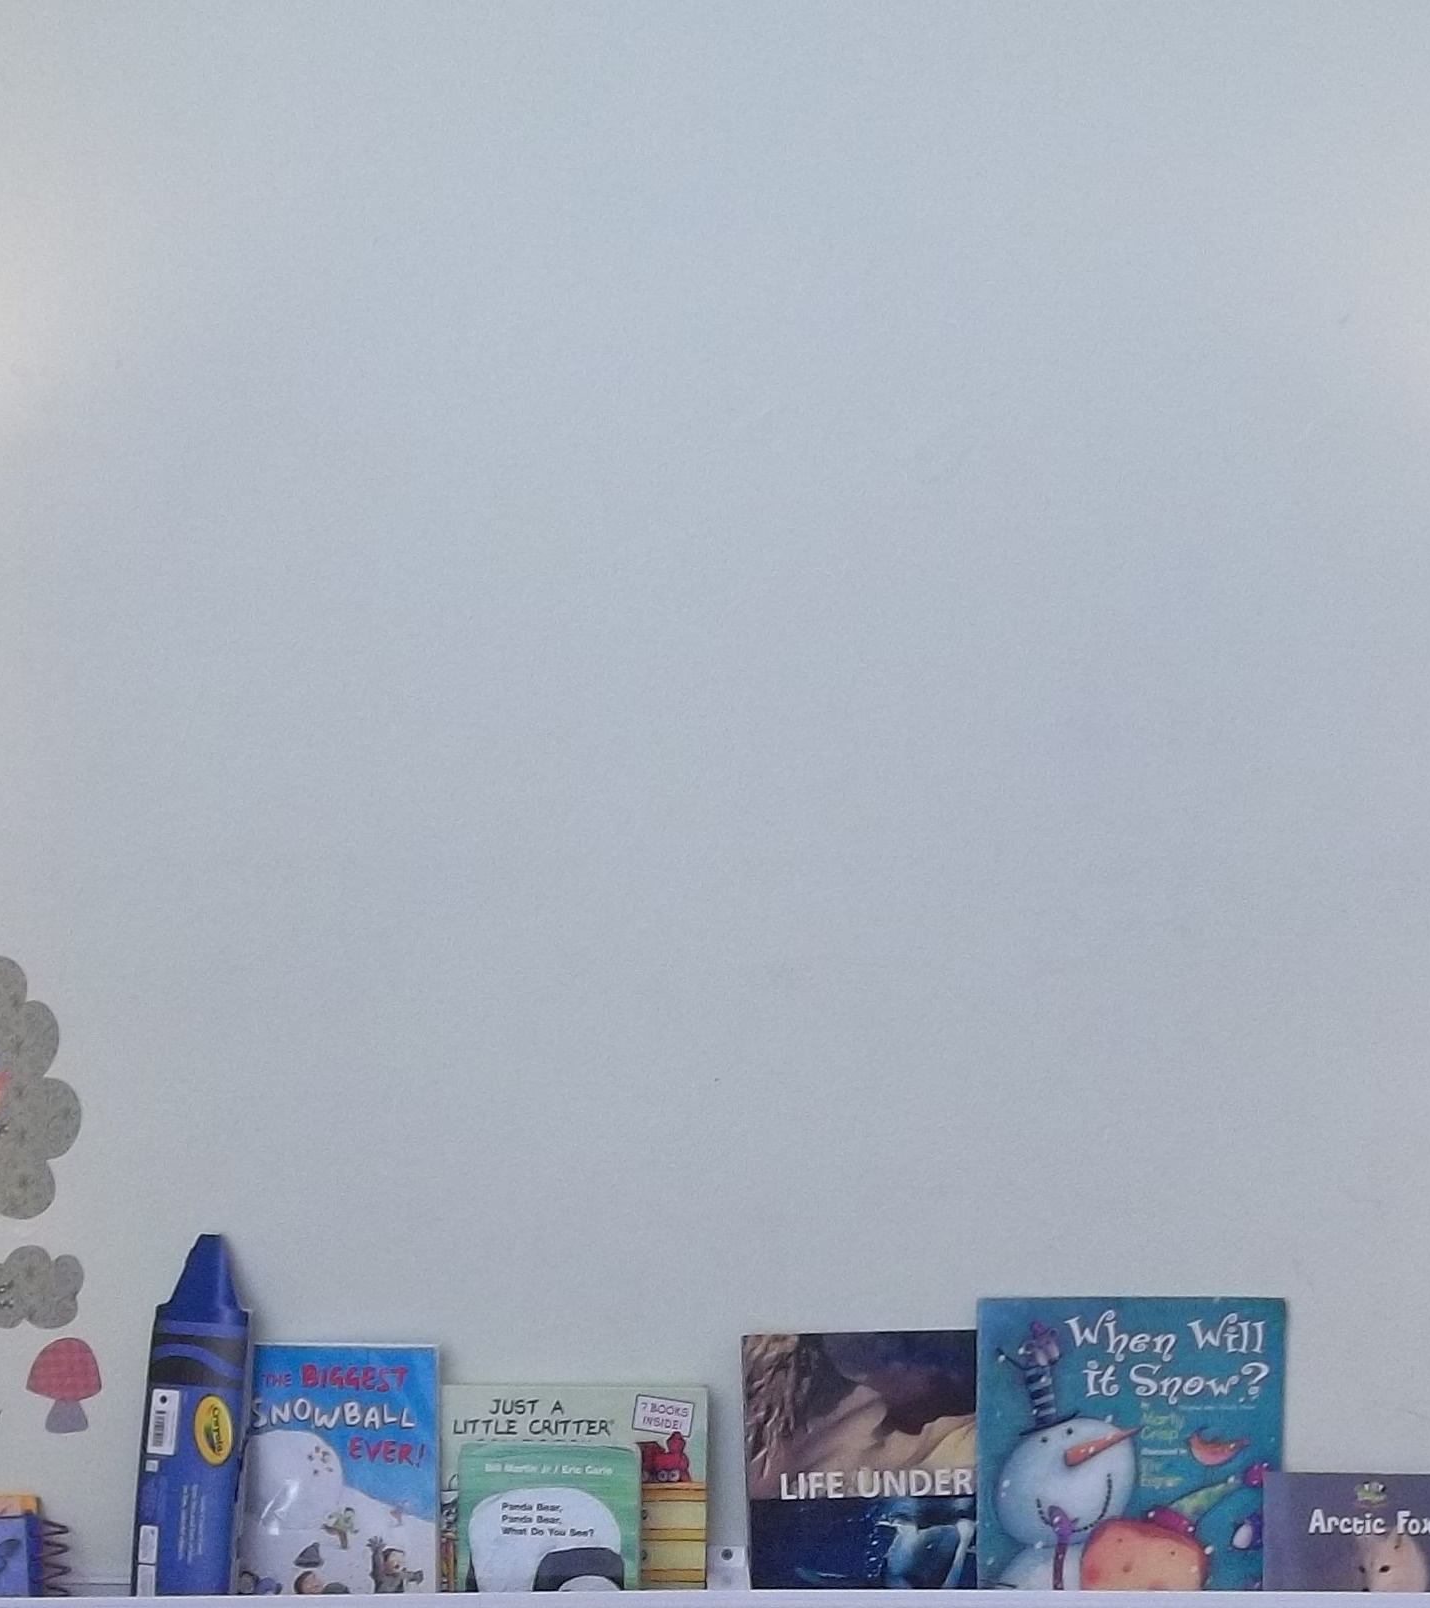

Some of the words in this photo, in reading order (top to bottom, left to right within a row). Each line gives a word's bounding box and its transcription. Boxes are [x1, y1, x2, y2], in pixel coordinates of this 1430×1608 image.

[1065, 1310, 1177, 1362] When
[1187, 1313, 1266, 1354] Will
[262, 1373, 292, 1387] THE
[301, 1364, 409, 1393] BIGGEST
[1128, 1362, 1270, 1405] Snow?
[252, 1398, 416, 1430] SNOWBALL
[489, 1399, 539, 1414] JUST
[551, 1400, 564, 1415] A
[650, 1402, 688, 1417] BOOKS
[210, 1405, 225, 1453] Crayola
[453, 1419, 518, 1435] LITTLE
[529, 1419, 611, 1436] CRITTER
[643, 1416, 682, 1430] INSIDE!
[348, 1437, 426, 1467] EVER!
[485, 1464, 502, 1473] Bill
[504, 1464, 538, 1473] Martin
[562, 1465, 582, 1474] Eric
[585, 1465, 613, 1475] Carle
[780, 1471, 845, 1500] LIFE
[857, 1467, 974, 1497] UNDER
[501, 1502, 533, 1511] Panda
[537, 1503, 563, 1513] Bear,
[501, 1514, 533, 1523] Panda
[537, 1515, 563, 1525] Bear,
[1308, 1508, 1386, 1536] Arctic
[501, 1527, 527, 1536] What
[531, 1527, 544, 1536] Do
[547, 1528, 566, 1536] You
[570, 1528, 594, 1537] See?
